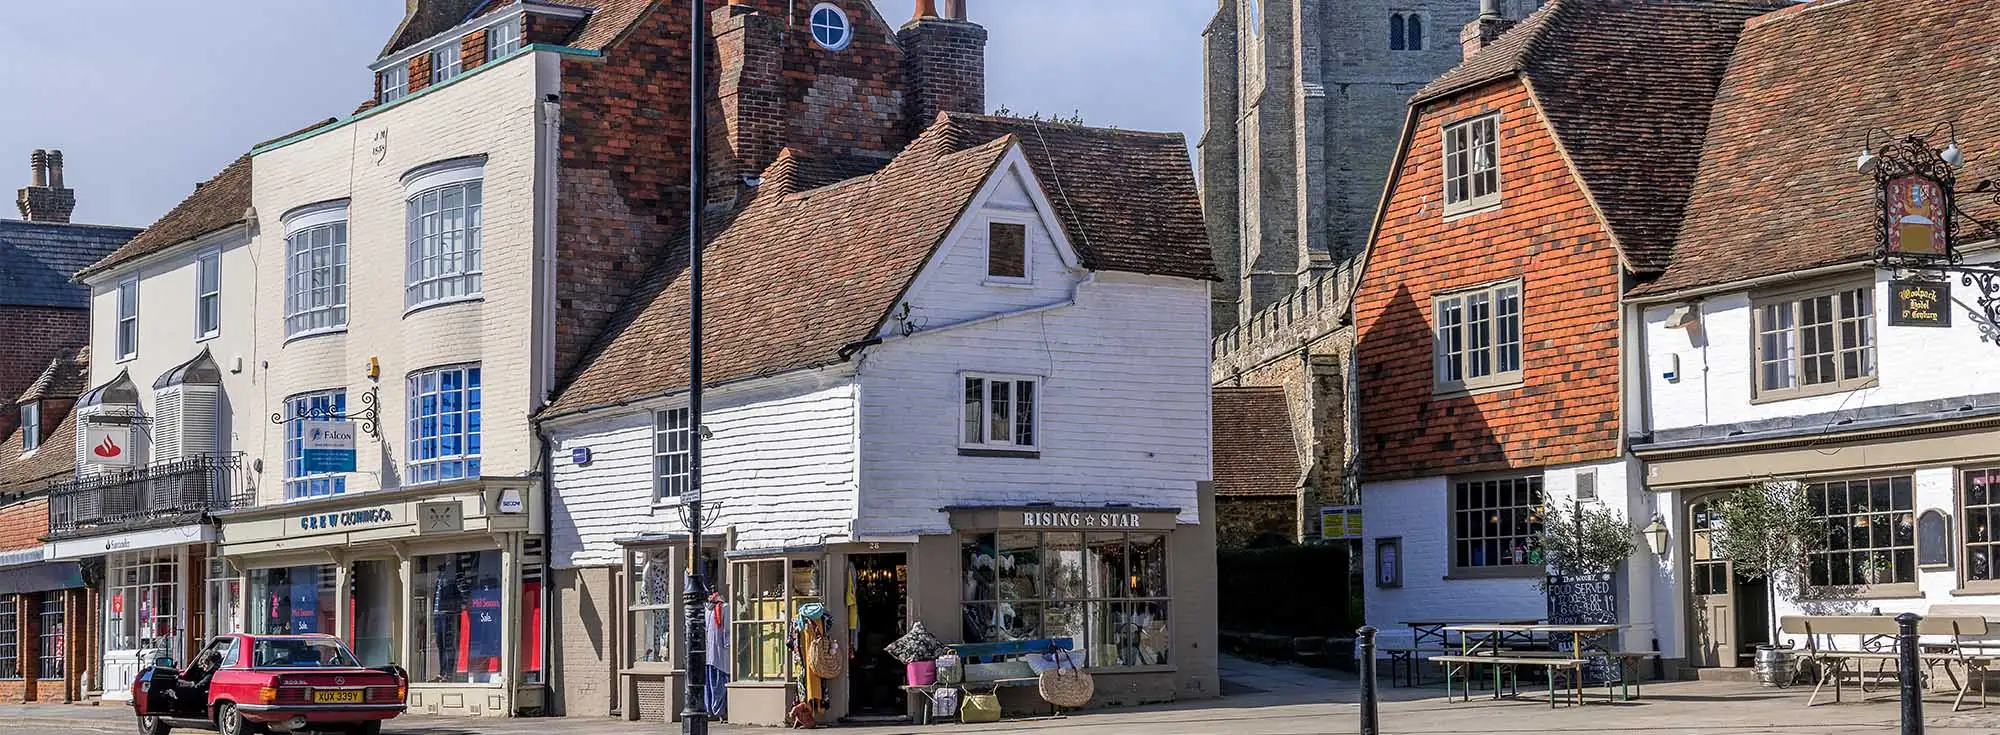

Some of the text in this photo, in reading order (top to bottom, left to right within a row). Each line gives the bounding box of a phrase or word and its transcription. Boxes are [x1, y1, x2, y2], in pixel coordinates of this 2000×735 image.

[324, 430, 352, 440] Falcon
[301, 514, 339, 530] CREW
[1023, 512, 1140, 528] RISING STAR
[1548, 581, 1610, 596] FOOD SERVED
[319, 691, 359, 702] XUX 339Y
